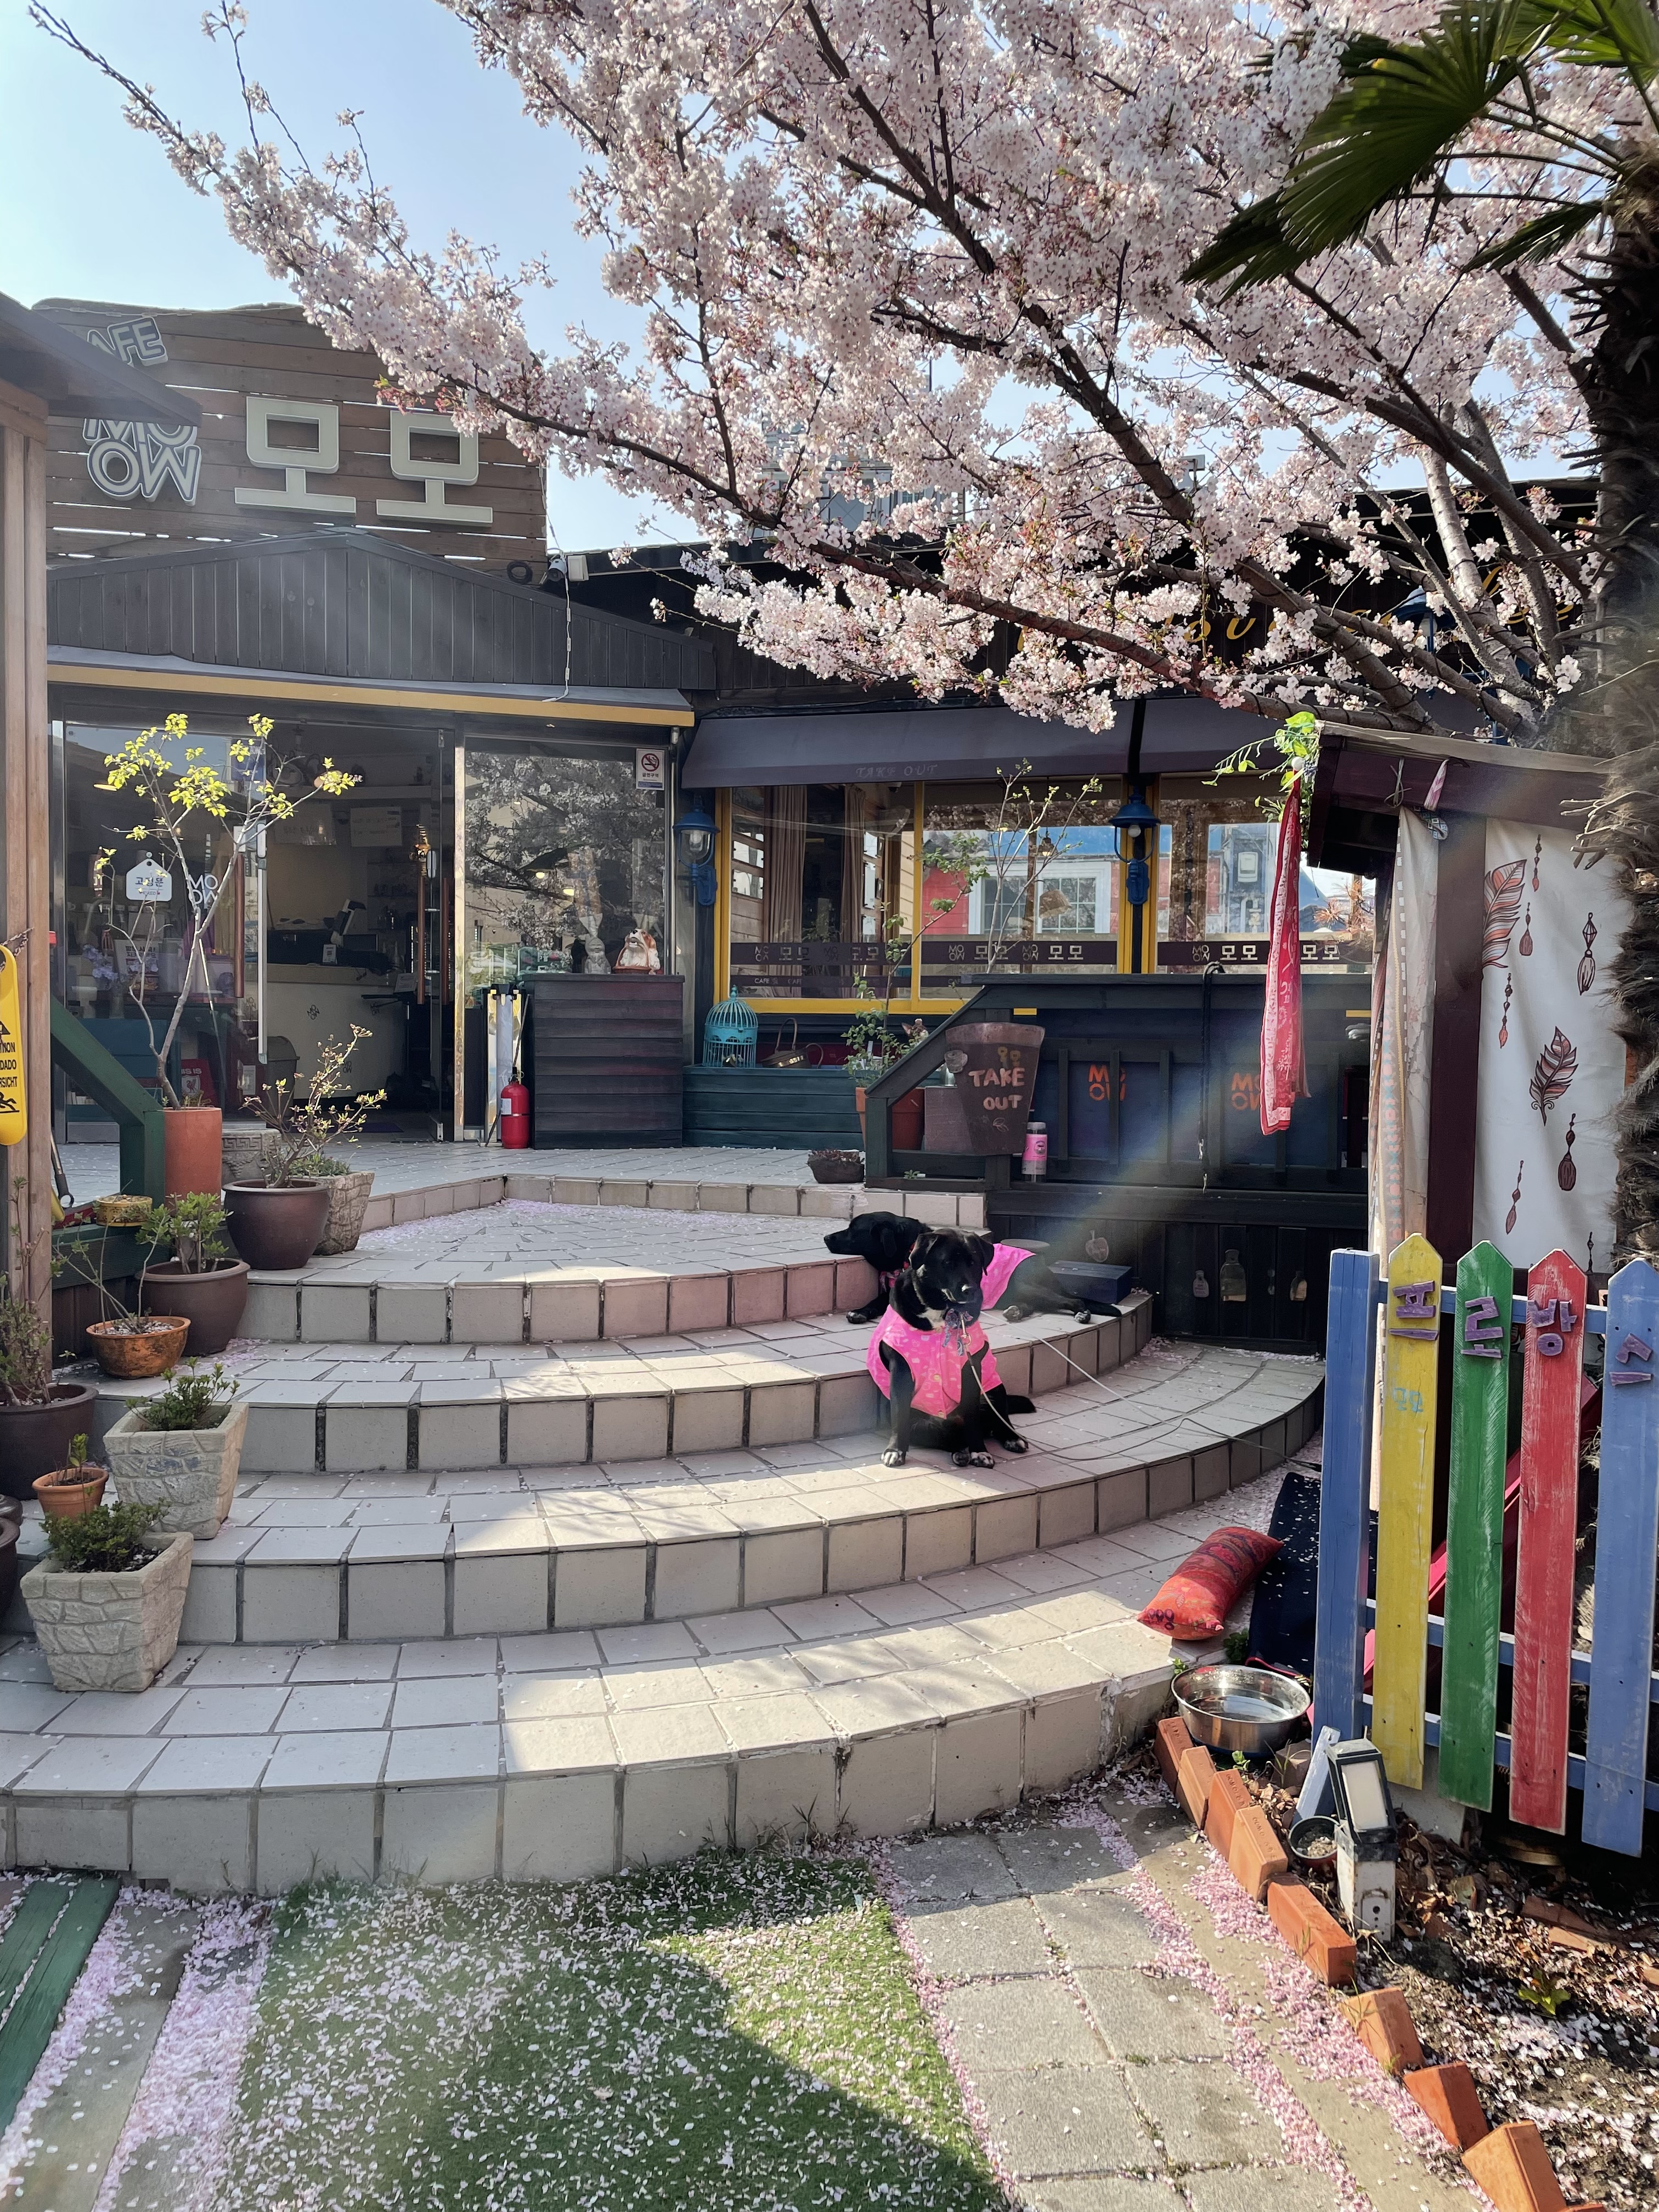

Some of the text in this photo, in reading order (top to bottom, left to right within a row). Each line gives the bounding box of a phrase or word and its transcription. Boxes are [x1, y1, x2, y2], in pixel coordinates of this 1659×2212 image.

[234, 396, 493, 526] 모모
[88, 440, 201, 501] OW
[855, 764, 938, 778] TAKE OUT
[1048, 945, 1084, 960] 모모
[1220, 945, 1258, 961] 모모
[1301, 945, 1340, 960] 모모
[968, 1068, 1025, 1087] TAKE
[983, 1094, 1023, 1110] OUT
